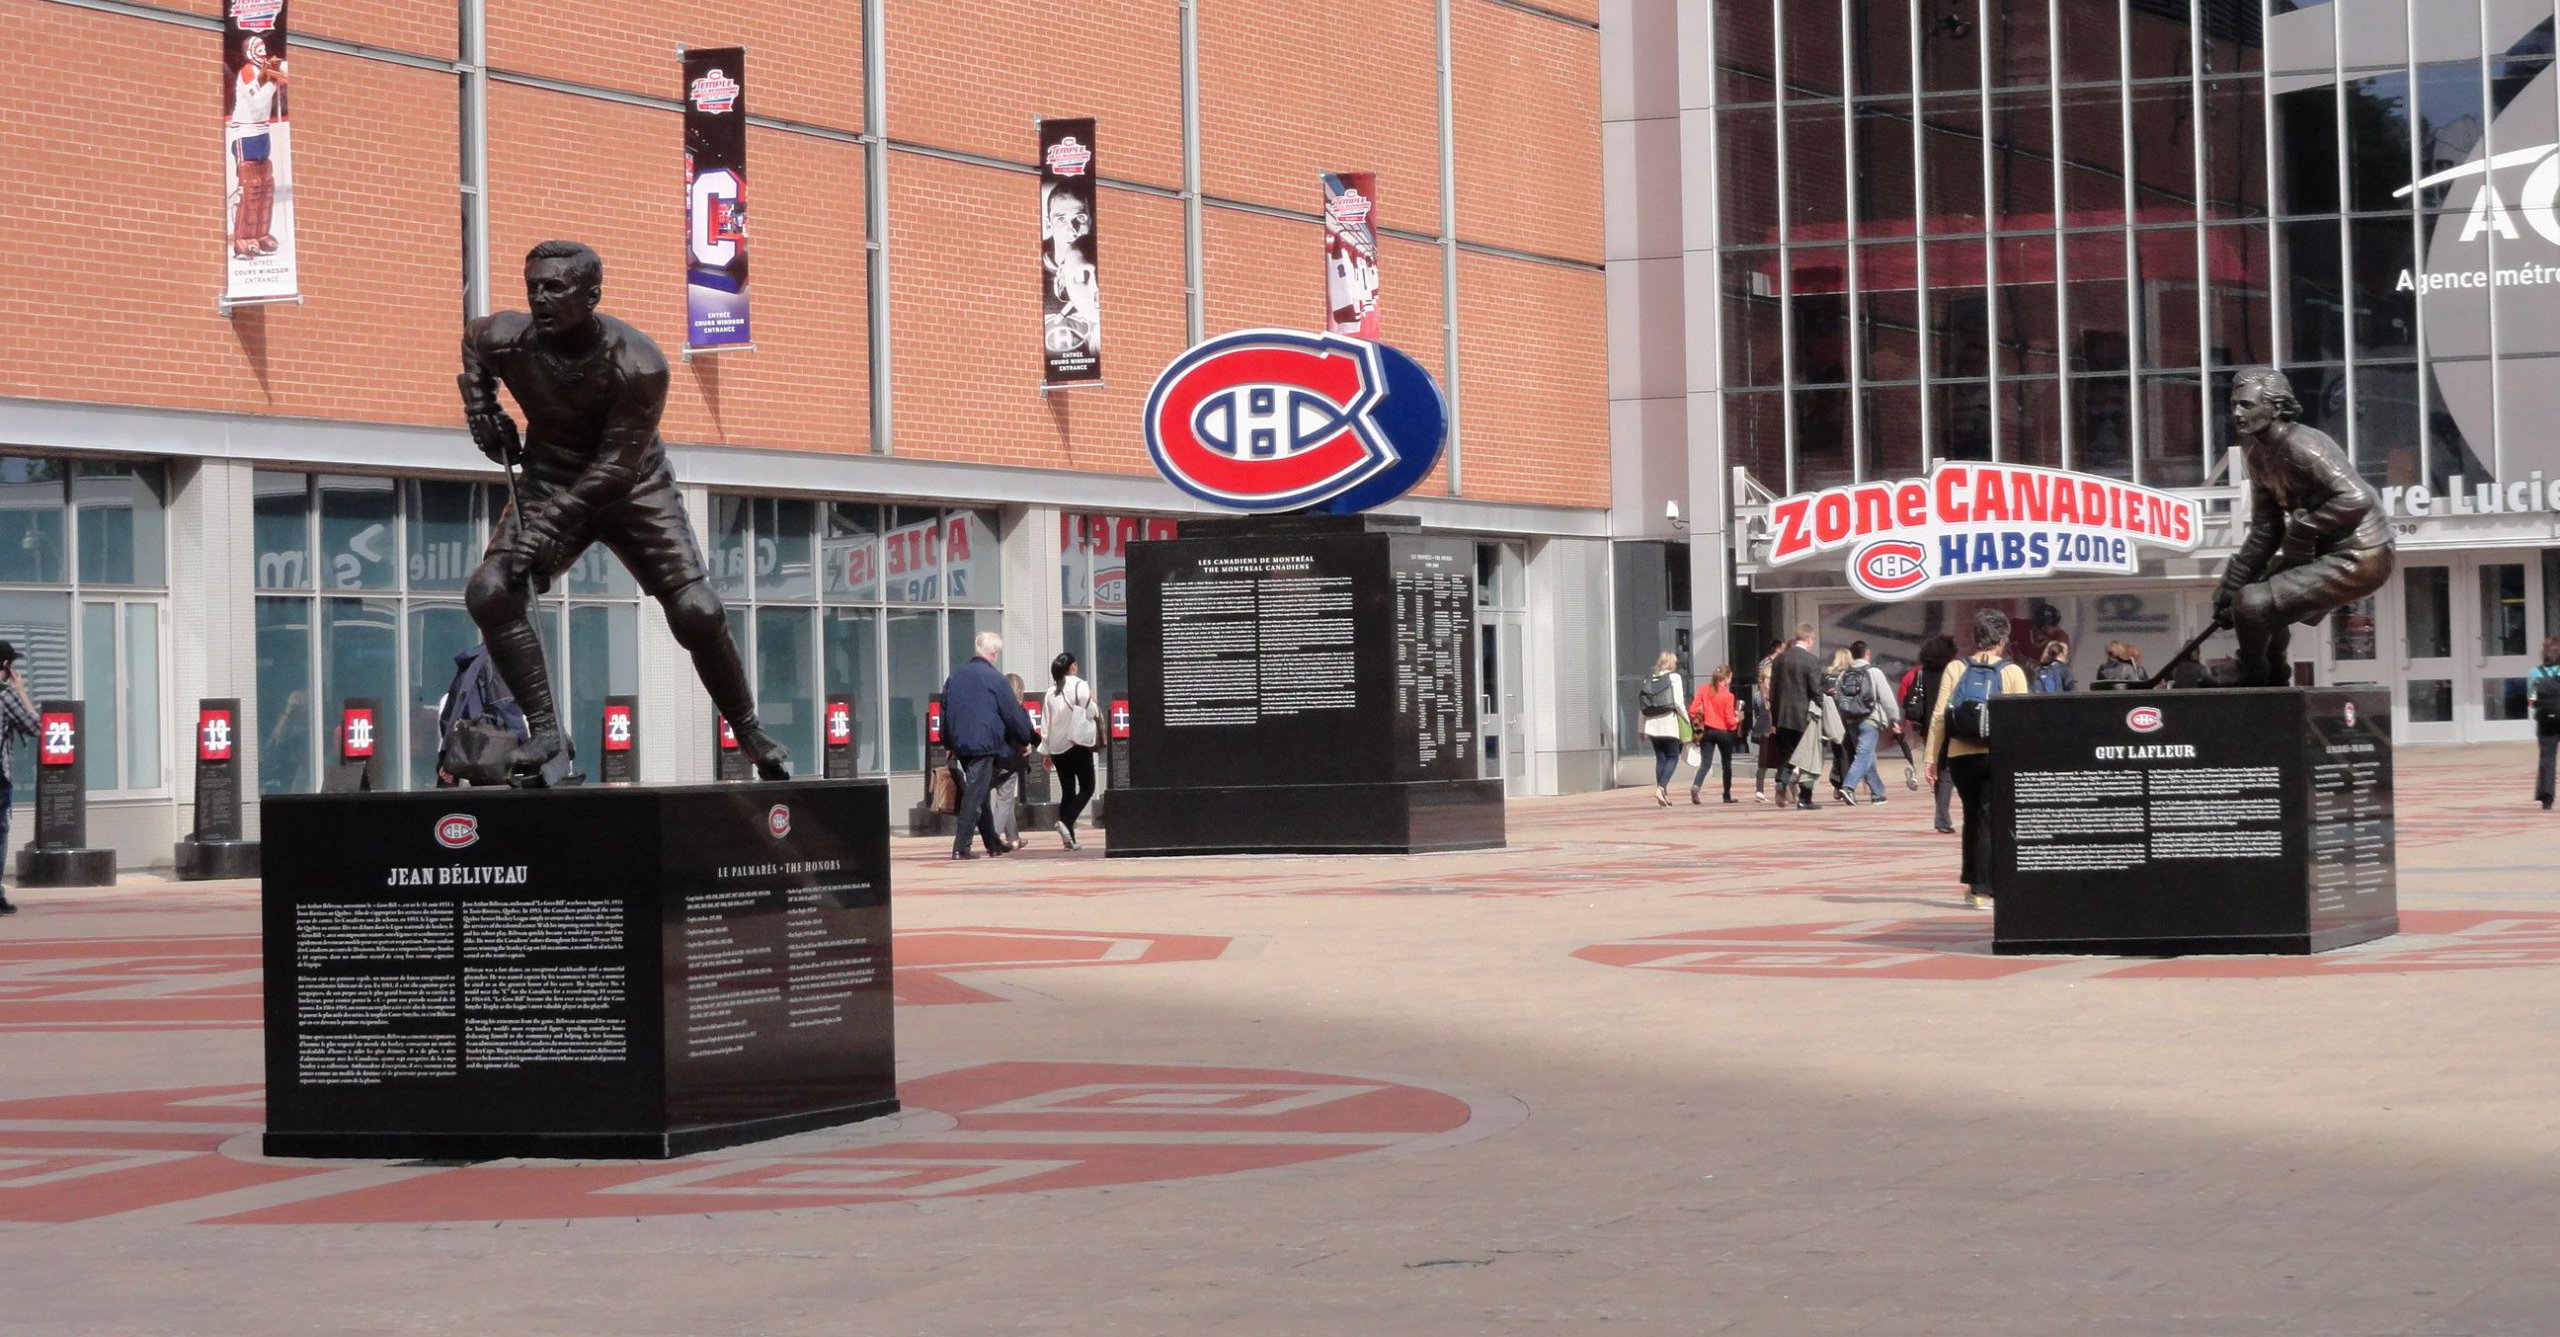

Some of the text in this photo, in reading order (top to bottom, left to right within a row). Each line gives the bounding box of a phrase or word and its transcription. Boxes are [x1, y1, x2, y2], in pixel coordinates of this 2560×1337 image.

[2395, 269, 2488, 295] Agence
[1935, 468, 2190, 542] CANADIENS
[1213, 557, 1258, 565] CANADIENS
[1273, 555, 1315, 564] MONTRÉAL
[1938, 532, 2050, 577] HABS
[1221, 565, 1263, 573] MONTREAL
[2095, 744, 2196, 760] GUY LAFLEUR
[387, 863, 528, 886] JEAN BÉLIVEAU
[718, 859, 841, 878] LE PALMARÈS THE HONORS
